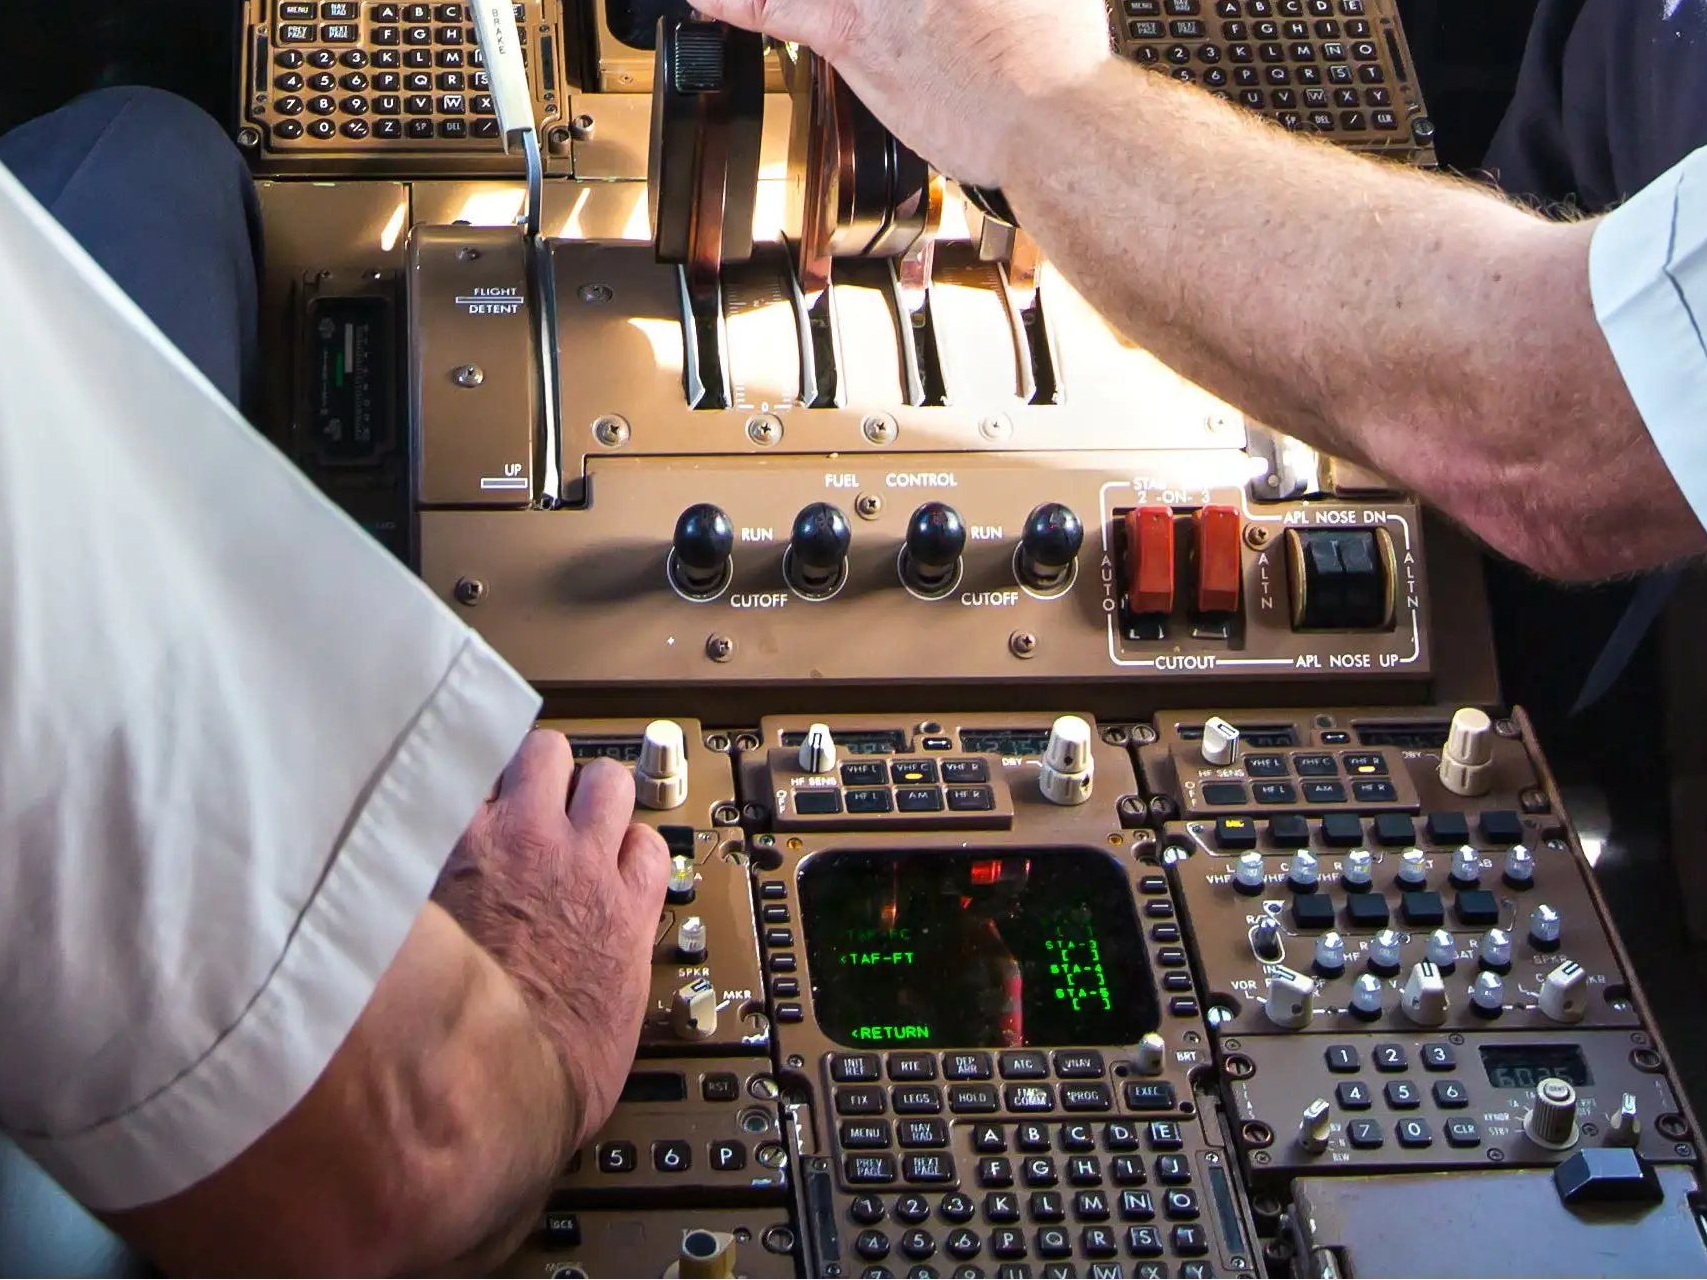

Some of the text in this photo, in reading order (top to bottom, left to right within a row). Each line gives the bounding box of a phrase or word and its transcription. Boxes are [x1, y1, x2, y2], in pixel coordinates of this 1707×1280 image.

[473, 287, 517, 296] FLIGHT
[468, 304, 518, 314] DETENT
[504, 463, 522, 477] UP
[824, 473, 958, 488] FUEL CONTROL
[1283, 509, 1387, 524] APL NOSE DN
[740, 527, 774, 542] RUN
[970, 526, 1004, 540] RUN
[1258, 553, 1273, 610] ALTN
[1404, 552, 1418, 607] ALTN
[730, 593, 788, 608] CUTOFF
[960, 591, 1020, 607] CUTOFF
[1154, 654, 1217, 670] CUTOUT
[1295, 653, 1399, 668] APL NOSE UP
[678, 967, 710, 978] SPKR
[860, 1025, 929, 1040] RETURN
[850, 1128, 880, 1139] MENU
